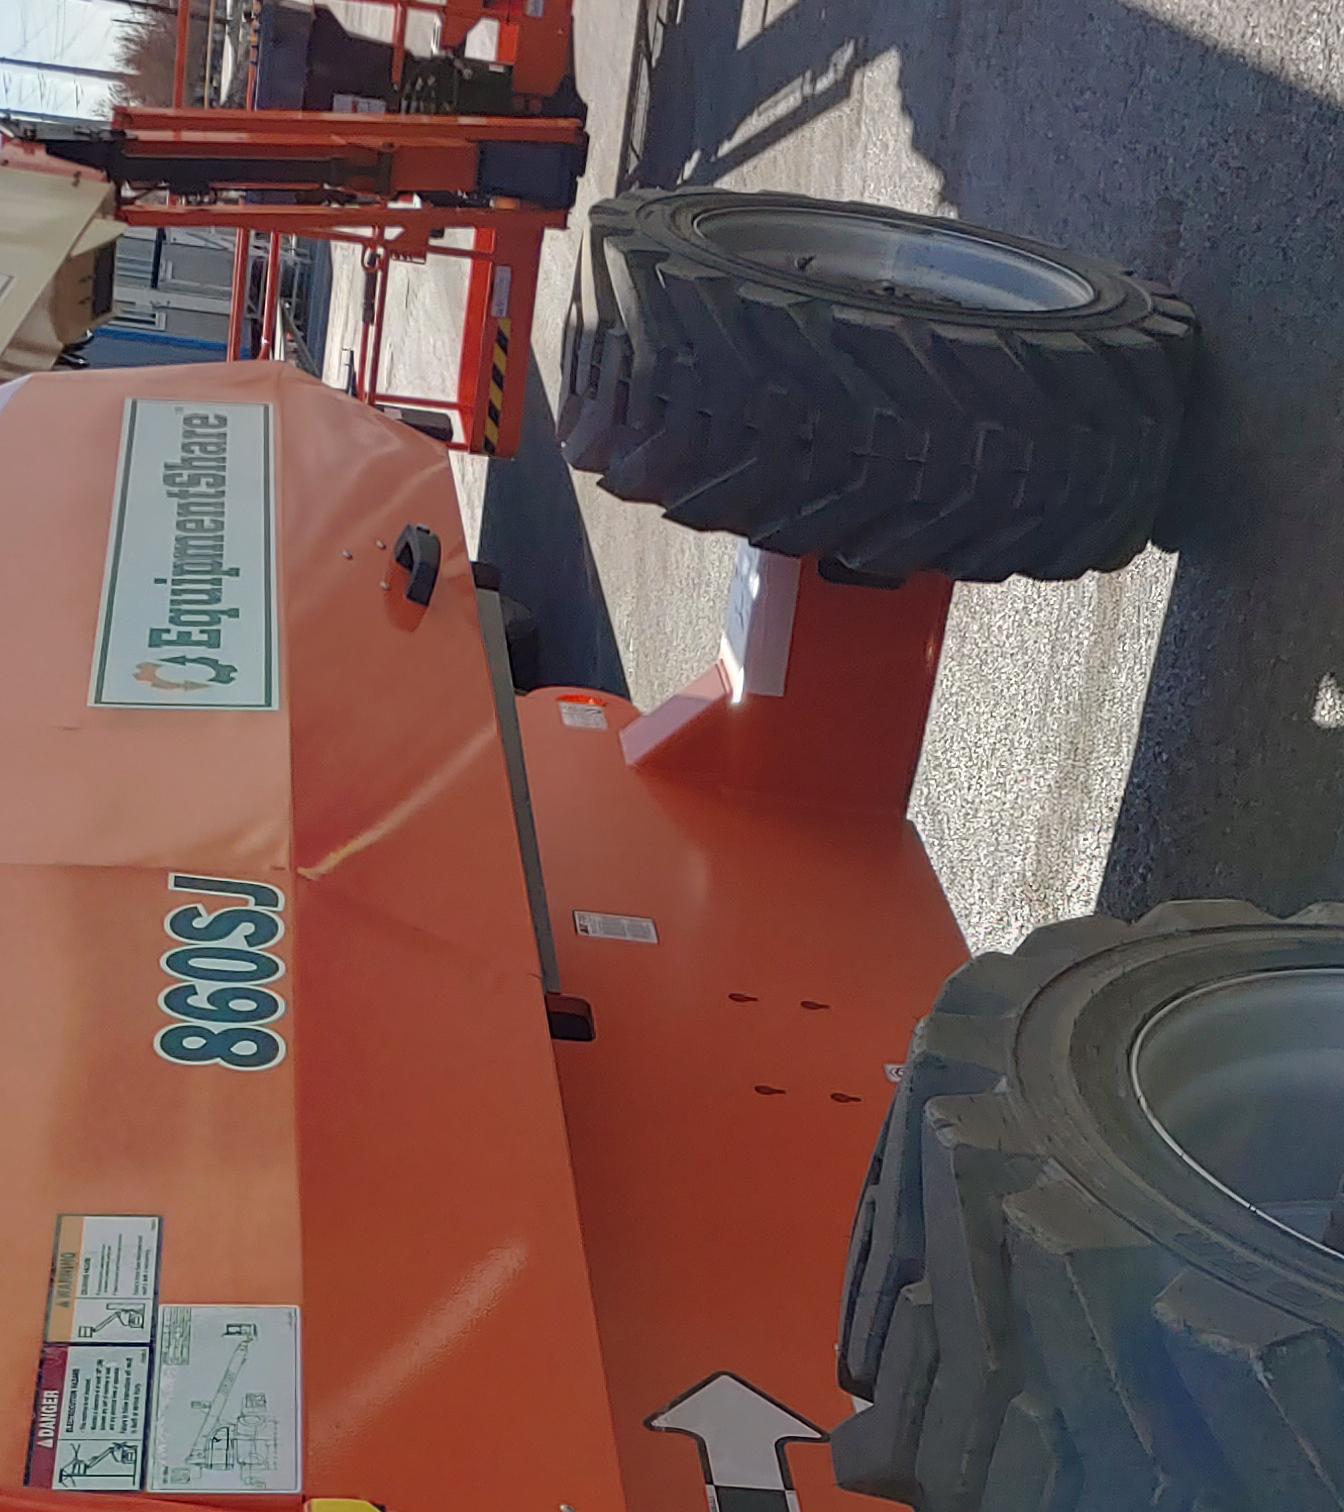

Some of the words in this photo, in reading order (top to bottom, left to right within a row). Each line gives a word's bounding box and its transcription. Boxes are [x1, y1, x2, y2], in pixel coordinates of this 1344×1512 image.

[148, 413, 240, 649] EquipmentShare
[159, 875, 279, 1067] 860SJ
[56, 1252, 75, 1298] WARNING
[37, 1390, 59, 1437] DANGER
